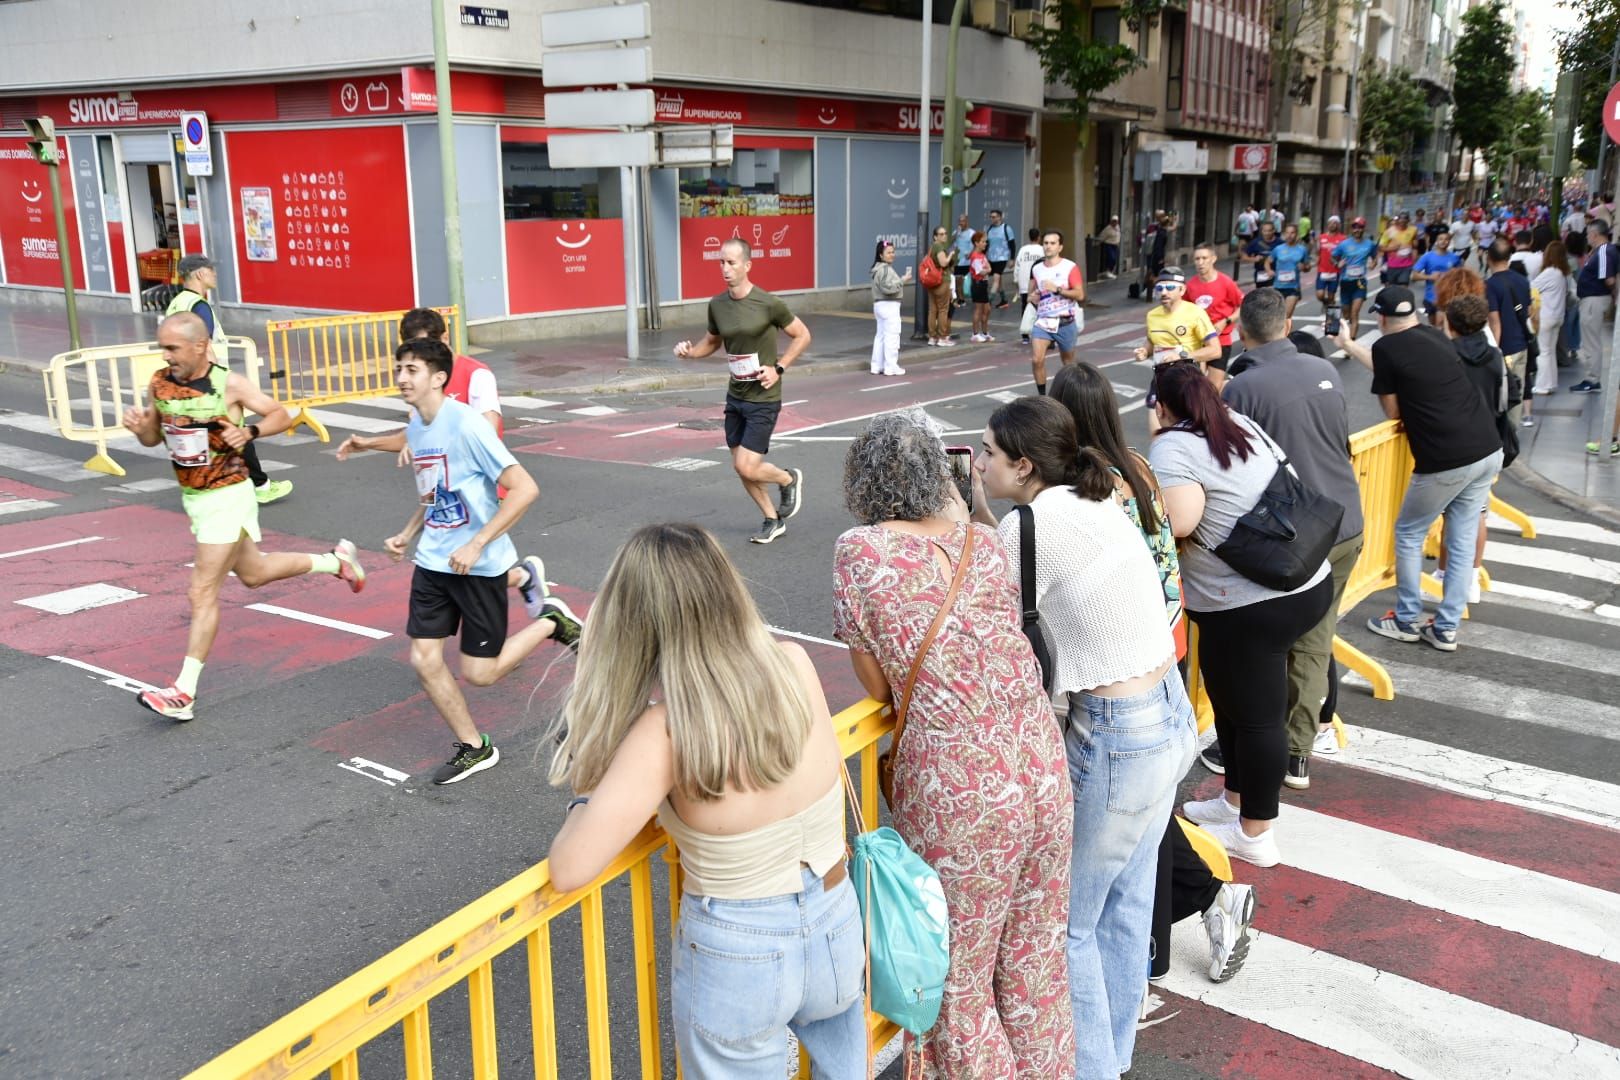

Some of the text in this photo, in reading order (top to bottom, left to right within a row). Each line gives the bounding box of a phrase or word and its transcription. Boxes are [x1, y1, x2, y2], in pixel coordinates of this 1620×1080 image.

[656, 101, 680, 112] EXPRESS
[139, 110, 182, 119] SUPERMERCADO
[684, 109, 741, 120] SUPERMERCADOS
[562, 254, 575, 262] Con
